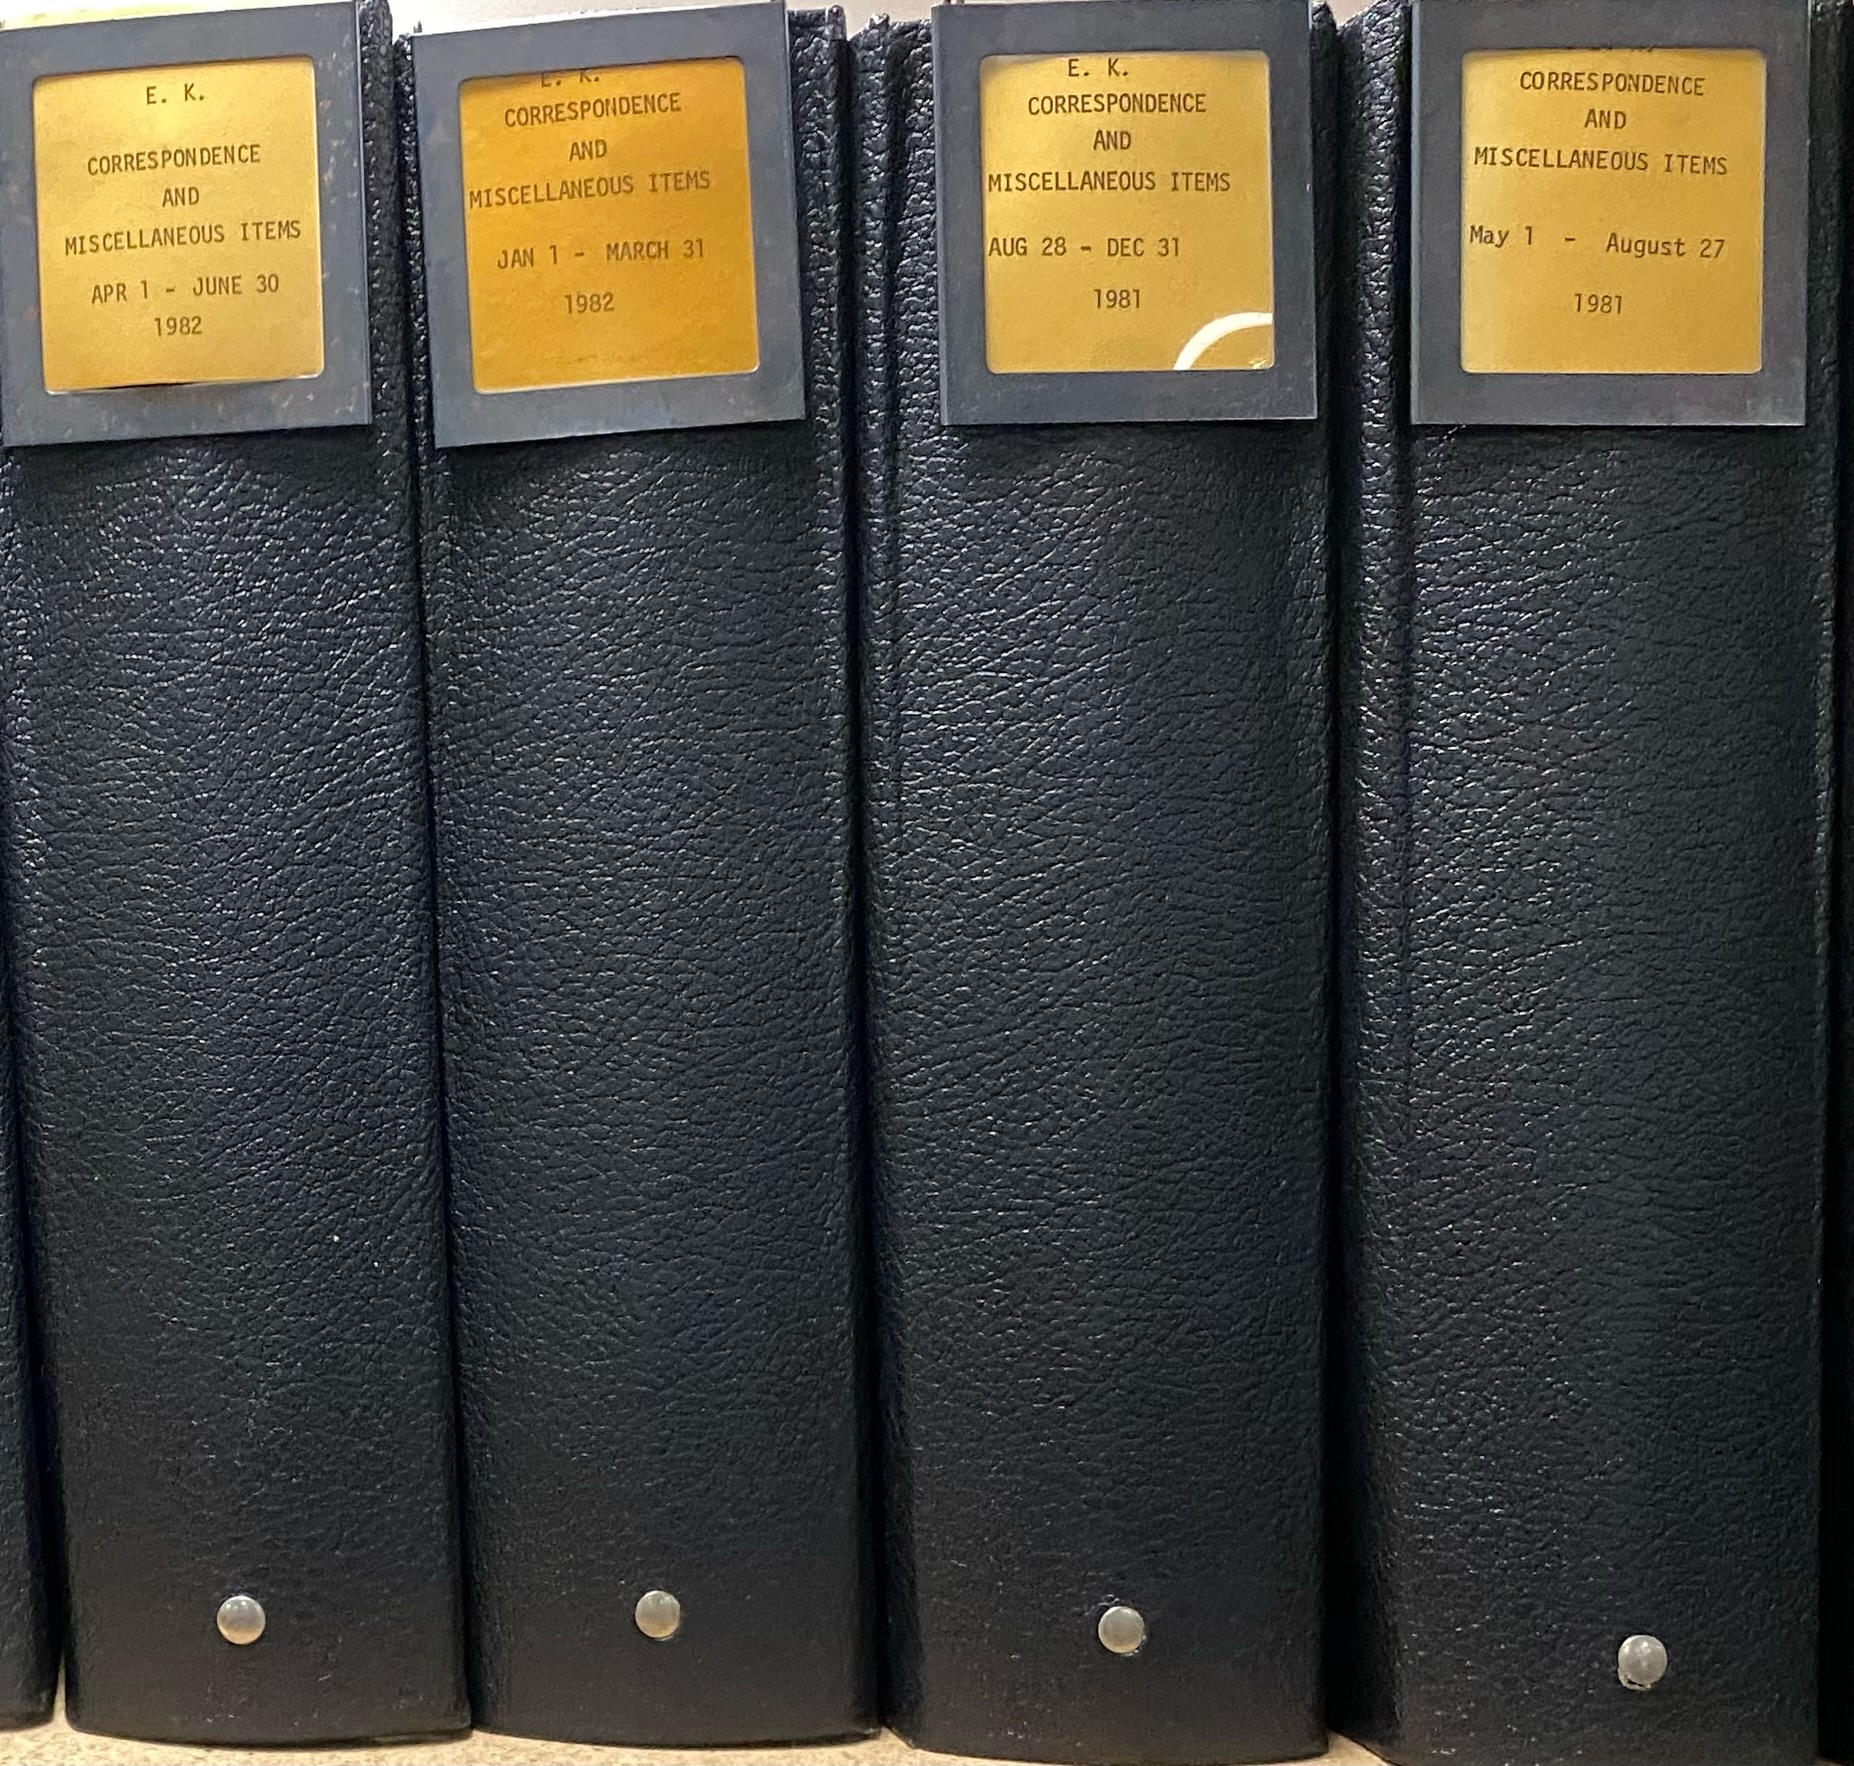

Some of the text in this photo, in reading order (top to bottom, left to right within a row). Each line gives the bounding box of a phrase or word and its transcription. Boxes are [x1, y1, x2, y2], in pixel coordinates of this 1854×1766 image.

[1067, 57, 1129, 78] E. K.
[146, 82, 205, 106] E. K.
[1519, 71, 1706, 97] CORRESPONDENCE
[504, 91, 682, 128] CORRESPONDENCE
[1028, 92, 1207, 116] CORRESPONDENCE
[1583, 108, 1627, 130] AND
[568, 138, 608, 163] AND
[1092, 128, 1132, 152] AND
[87, 143, 261, 176] CORRESPONDENCE
[1473, 146, 1728, 176] MISCELLANEOUS ITEMS
[469, 169, 711, 209] MISCELLANEOUS ITEMS
[988, 170, 1231, 193] MISCELLANEOUS ITEMS
[161, 186, 200, 208] AND
[64, 219, 301, 257] MISCELLANEOUS ITEMS
[988, 236, 1028, 257] AUG
[1041, 235, 1067, 257] 28
[1107, 237, 1145, 258] DEC
[1157, 237, 1179, 258] 31
[1469, 224, 1510, 249] May
[1524, 225, 1533, 246] 1
[1605, 231, 1687, 259] August
[1699, 237, 1726, 259] 27
[497, 247, 535, 270] JAN
[549, 244, 558, 265] 1
[605, 239, 670, 262] MARCH
[683, 237, 704, 259] 31
[91, 282, 128, 305] APR
[140, 279, 148, 300] 1
[192, 274, 243, 297] JUNE
[256, 273, 280, 294] 30
[1093, 288, 1140, 310] 1981
[564, 291, 616, 315] 1982
[1574, 292, 1623, 315] 1981
[154, 315, 203, 337] 1982
